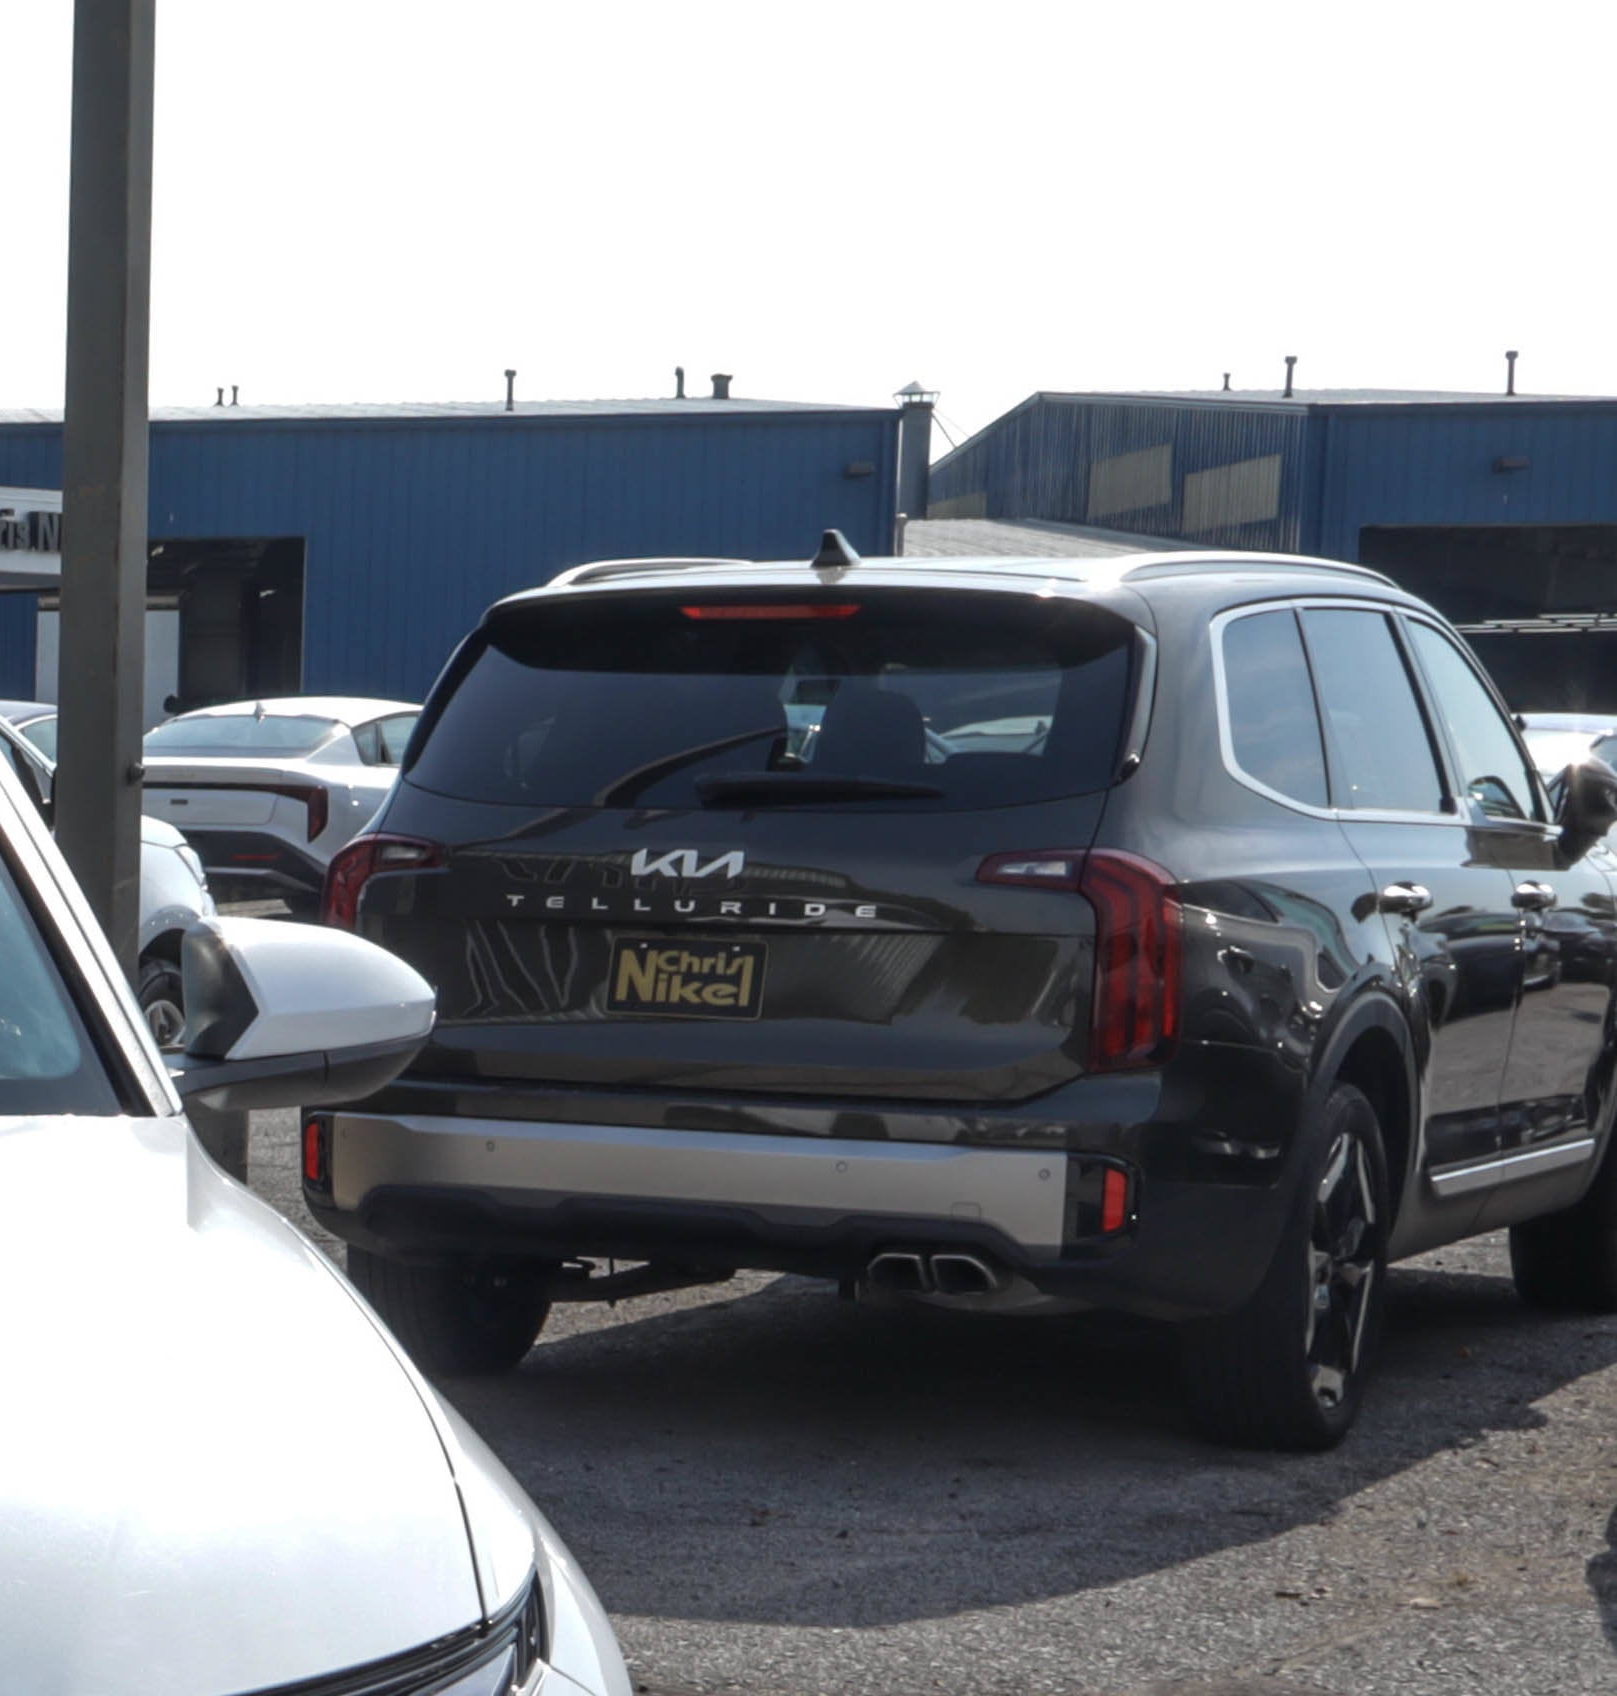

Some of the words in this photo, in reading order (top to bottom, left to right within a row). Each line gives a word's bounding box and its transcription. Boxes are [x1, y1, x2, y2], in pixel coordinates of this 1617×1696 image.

[631, 848, 745, 879] KIA
[507, 895, 876, 917] TELLURIDE
[616, 949, 752, 1007] Nikel
[659, 950, 747, 977] Chris
